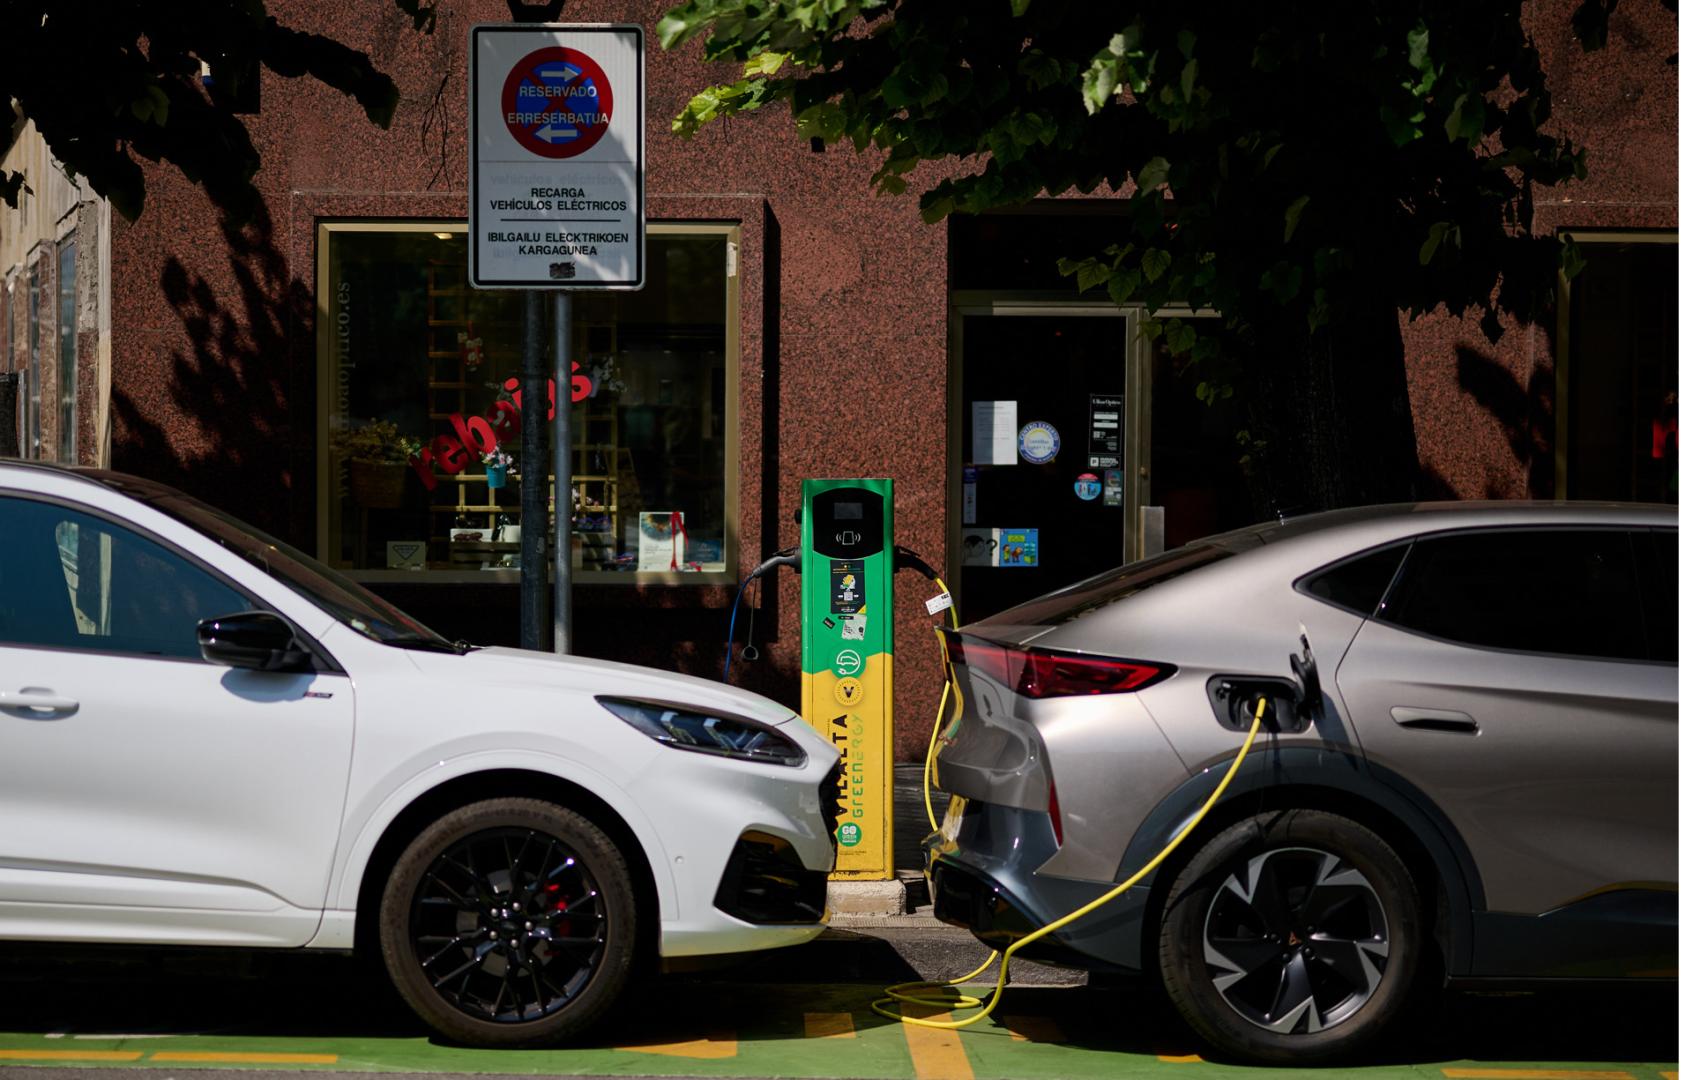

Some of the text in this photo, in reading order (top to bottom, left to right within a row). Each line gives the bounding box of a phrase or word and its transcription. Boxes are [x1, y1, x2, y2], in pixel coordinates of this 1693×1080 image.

[519, 86, 597, 98] RESERVADO
[507, 112, 609, 125] ERRESERBATUA
[530, 187, 585, 198] RECARGA
[489, 197, 627, 211] VEHÍCULOS ELÉCTRICOS
[487, 232, 629, 244] IBILGAILU ELECKTRIKOEN
[518, 245, 598, 256] KARGAGUNEA
